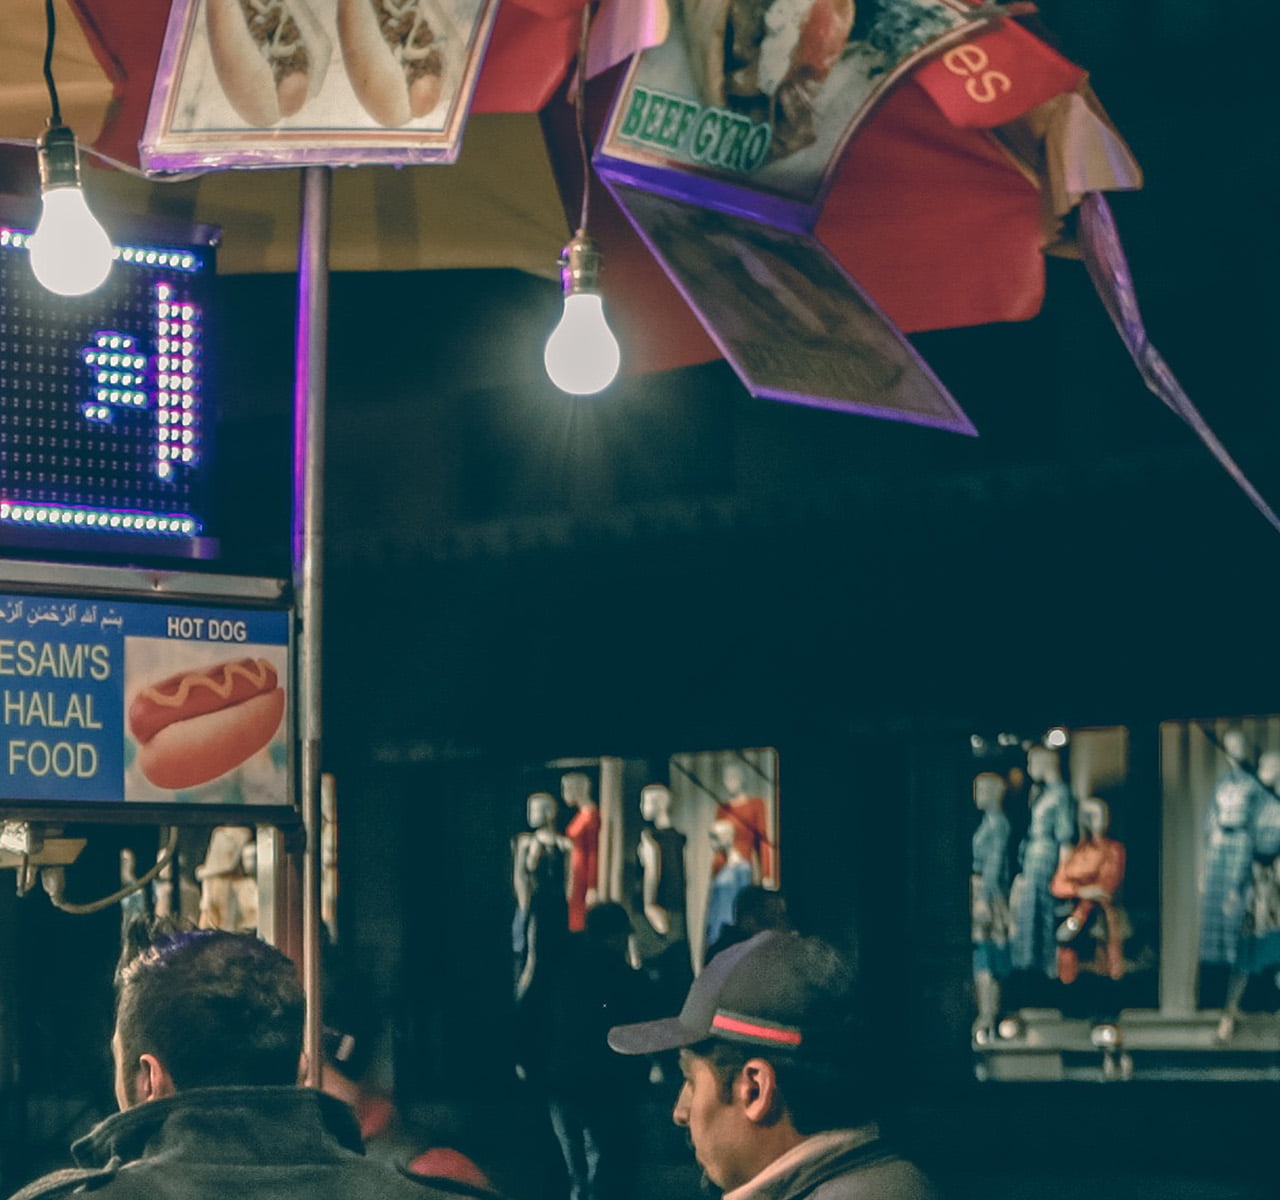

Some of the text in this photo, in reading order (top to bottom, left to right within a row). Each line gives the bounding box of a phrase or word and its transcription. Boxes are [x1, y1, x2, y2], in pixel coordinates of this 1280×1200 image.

[620, 90, 772, 173] BEEF GYRO
[166, 616, 247, 643] HOT DOG
[3, 690, 103, 730] HALAL
[7, 740, 99, 780] FOOD
